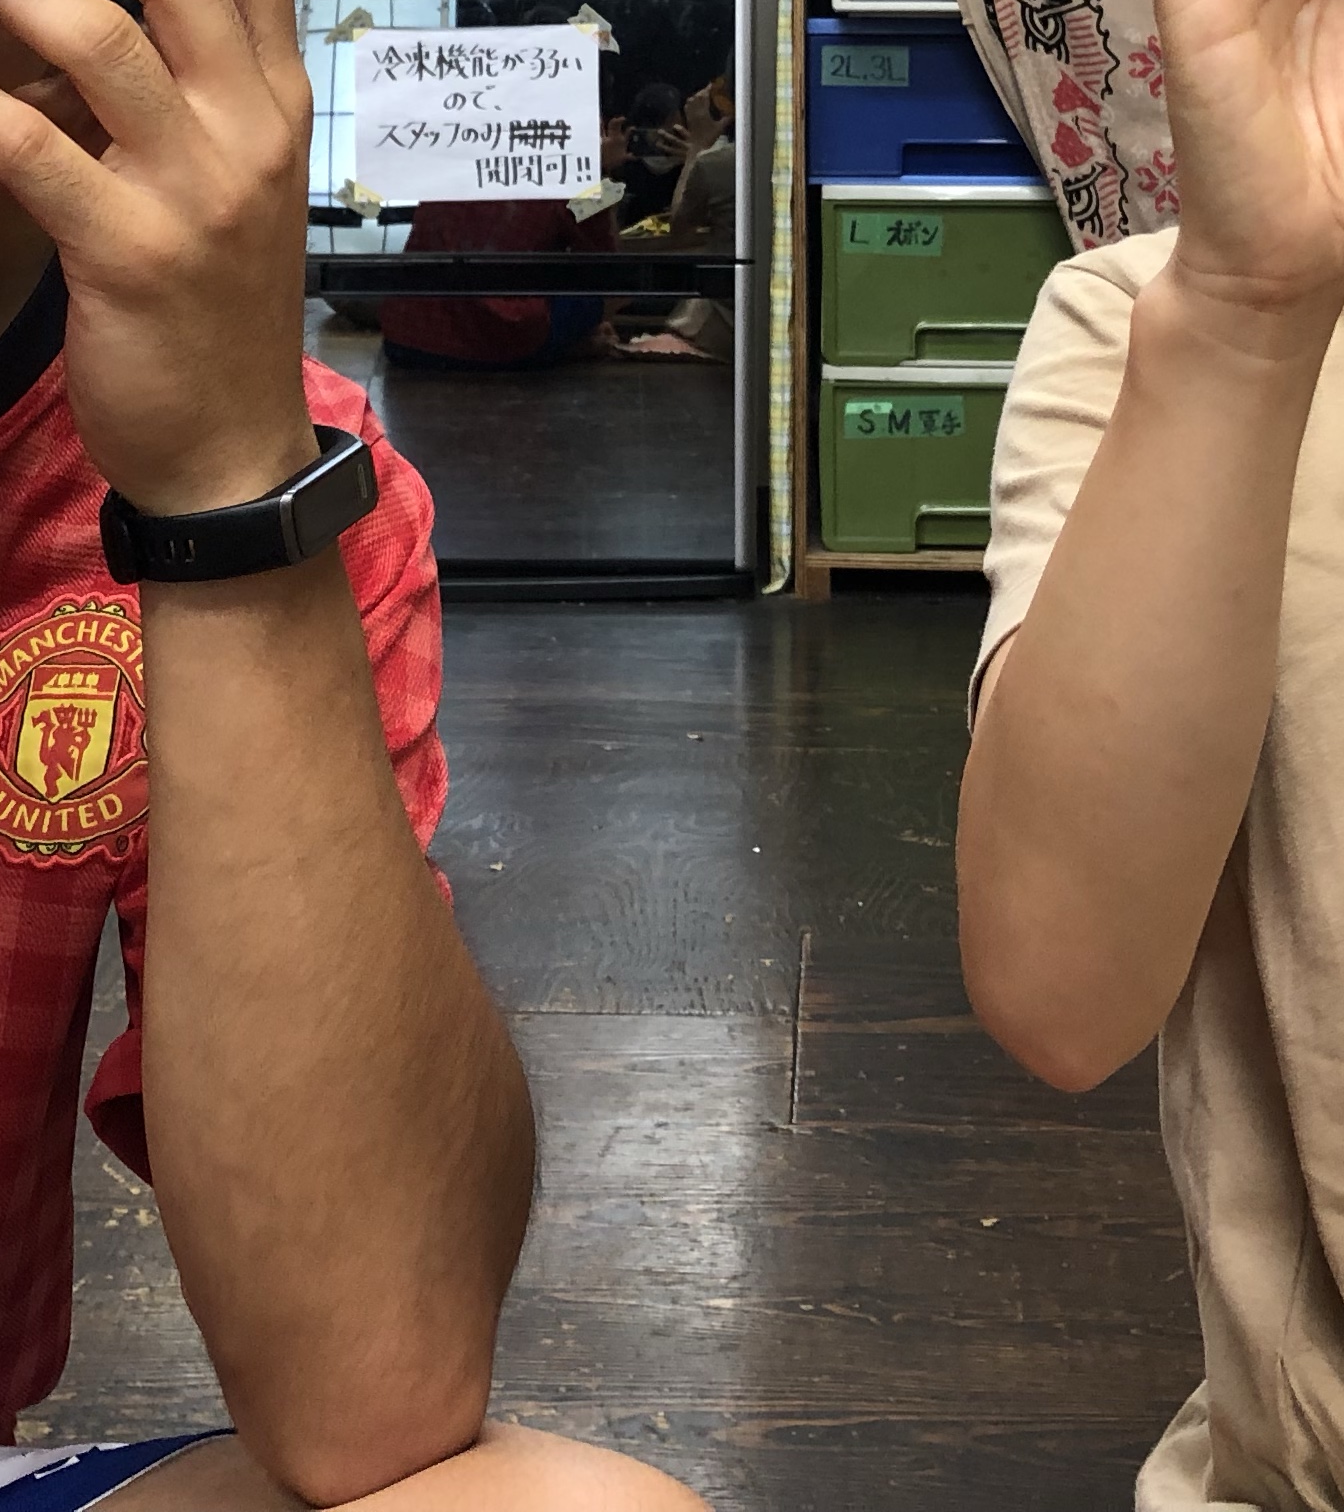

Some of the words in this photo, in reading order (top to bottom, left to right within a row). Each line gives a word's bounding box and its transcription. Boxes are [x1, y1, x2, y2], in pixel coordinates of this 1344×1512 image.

[372, 40, 583, 82] 冷凍機能が弱い
[376, 120, 502, 150] スタッフのみ
[849, 220, 869, 245] L
[887, 219, 939, 246] ズボン
[918, 409, 961, 436] 軍手
